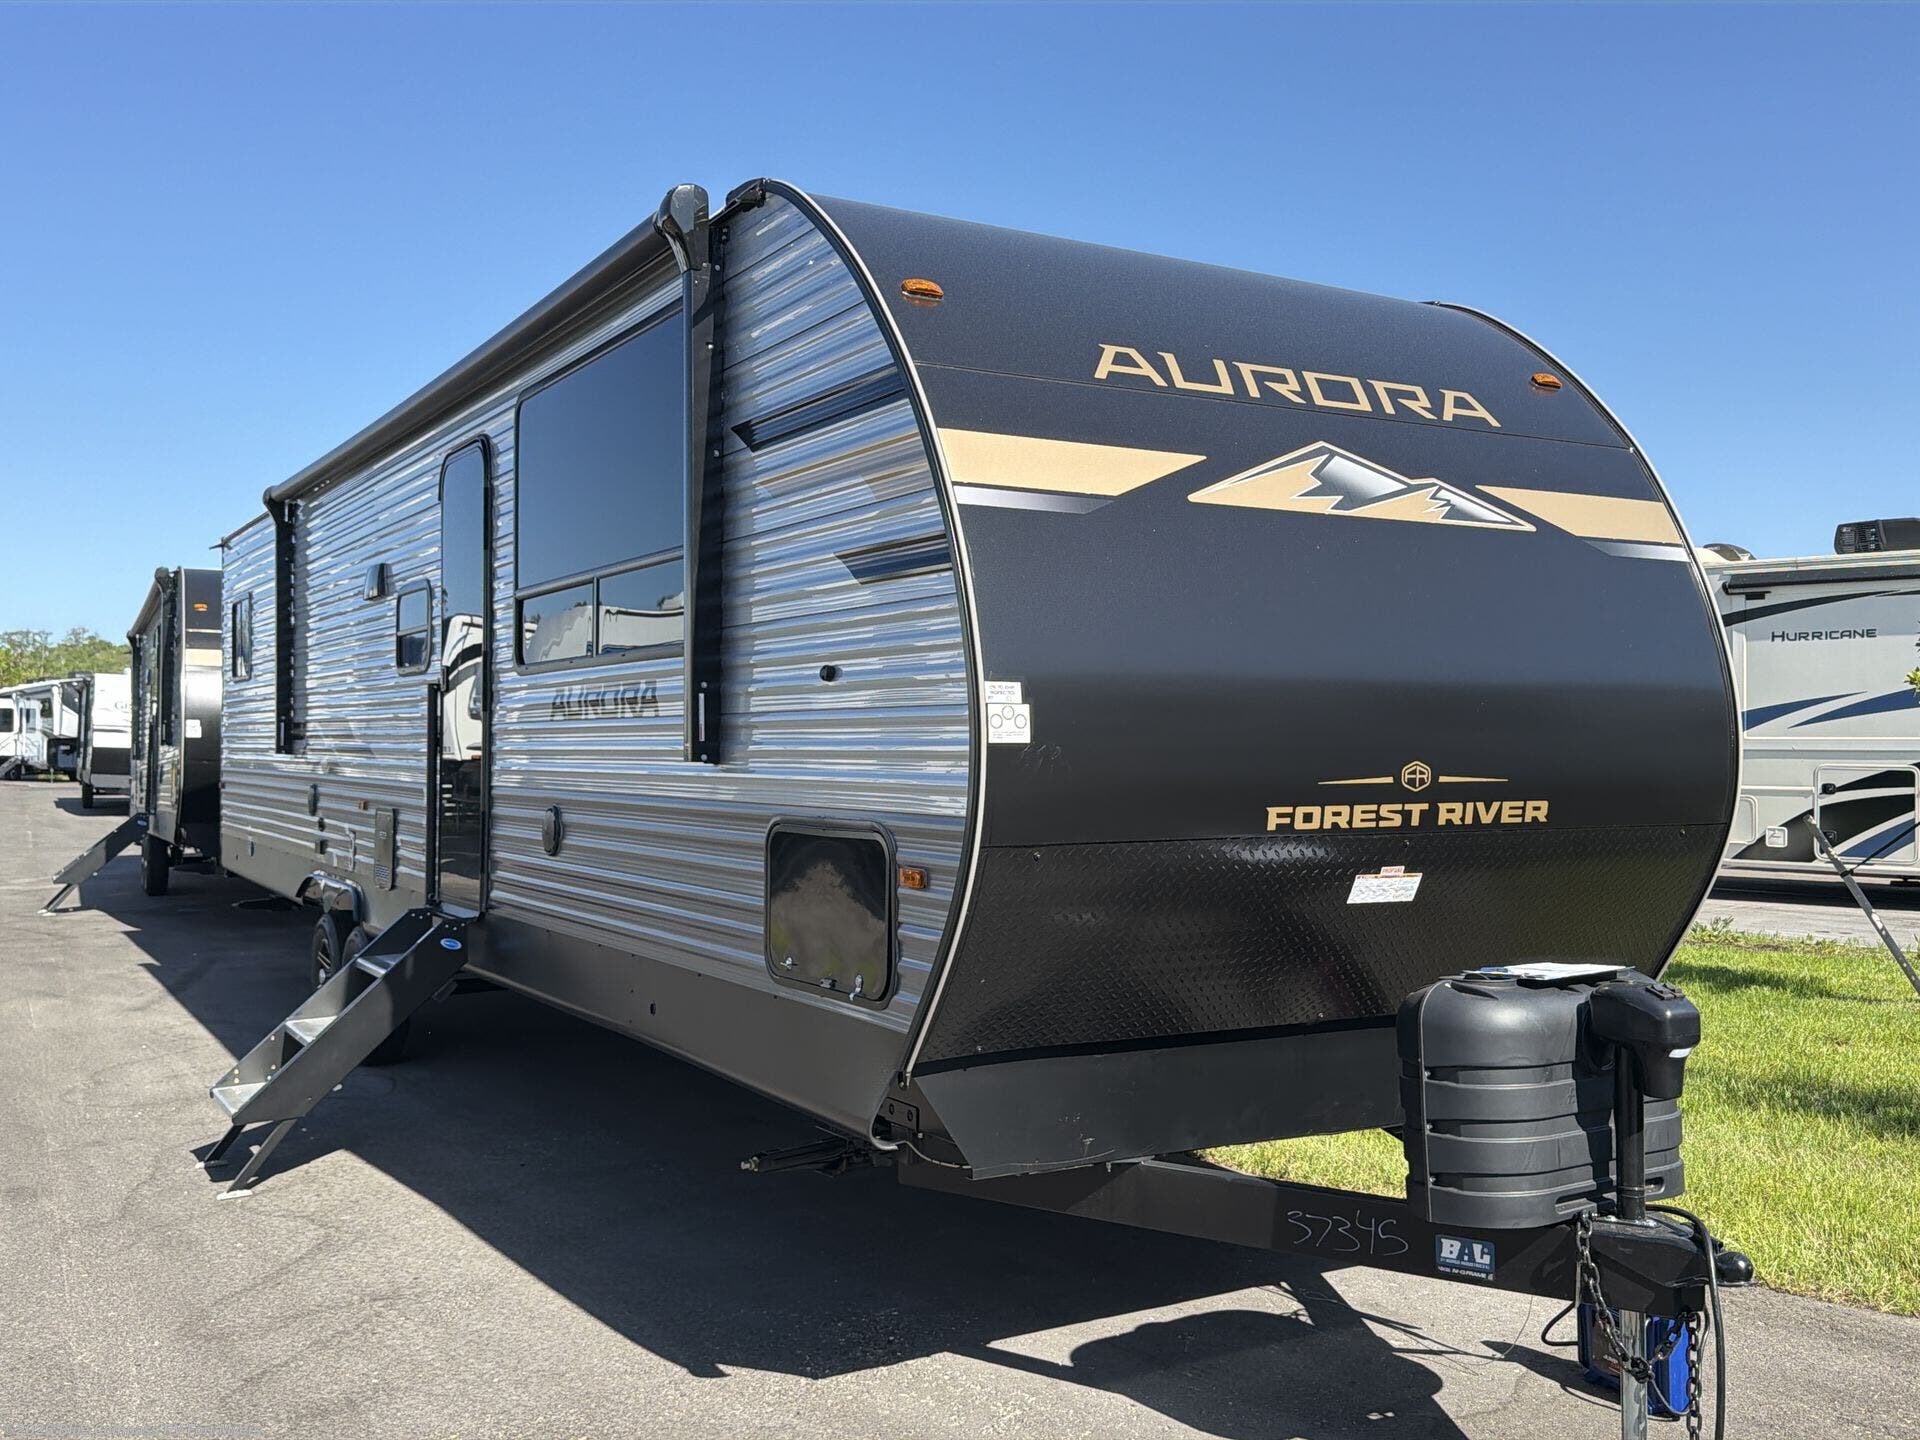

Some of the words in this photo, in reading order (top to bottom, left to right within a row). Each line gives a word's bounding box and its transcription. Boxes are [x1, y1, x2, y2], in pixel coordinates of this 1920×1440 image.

[1094, 343, 1501, 428] AURORA
[1771, 628, 1877, 642] HURRICANE
[550, 681, 659, 721] AURORA
[1266, 802, 1429, 831] FOREST
[1437, 800, 1549, 826] RIVER
[1286, 1209, 1409, 1256] 37345
[1440, 1238, 1491, 1264] BAL
